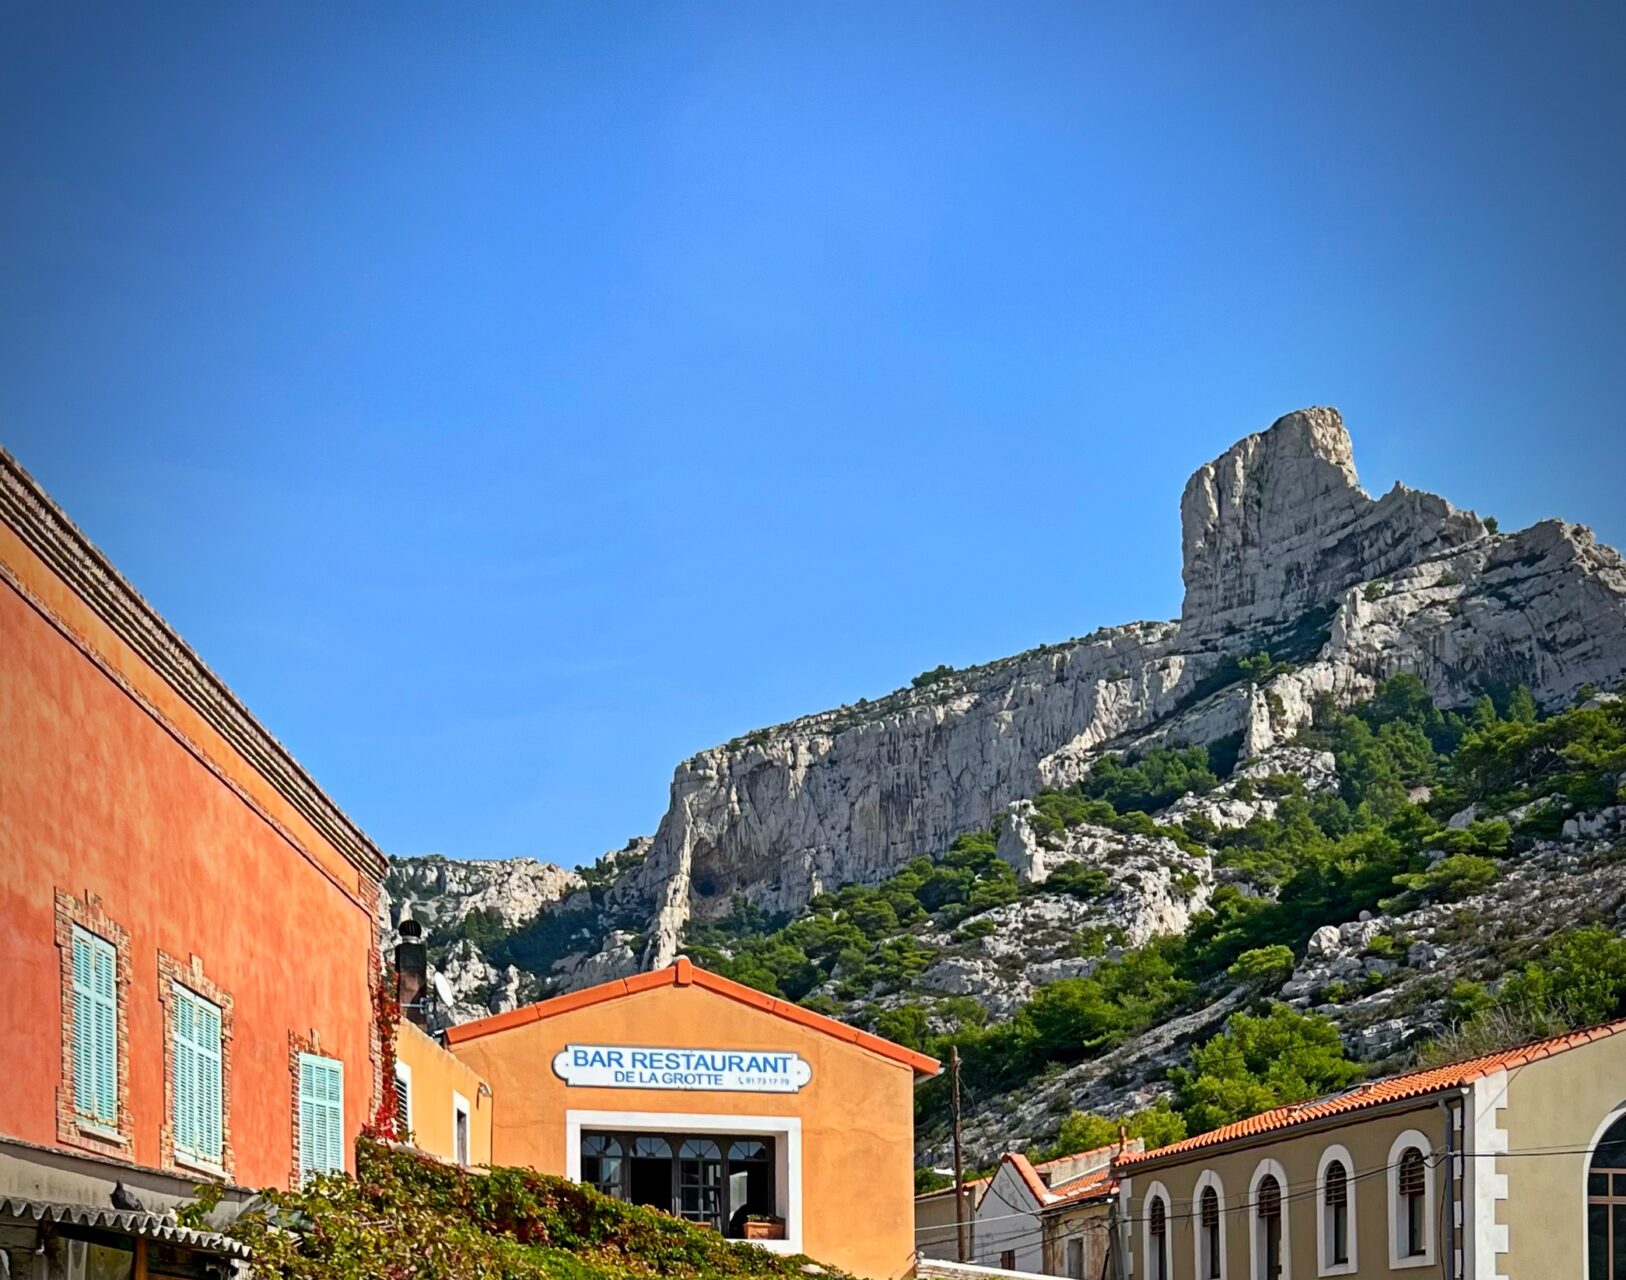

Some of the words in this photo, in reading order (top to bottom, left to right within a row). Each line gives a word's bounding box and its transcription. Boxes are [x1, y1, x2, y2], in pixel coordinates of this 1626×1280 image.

[573, 1050, 623, 1068] BAR
[631, 1051, 792, 1074] RESTAURANT
[614, 1071, 635, 1083] DE
[639, 1072, 659, 1084] LA
[662, 1072, 723, 1086] GROTTE
